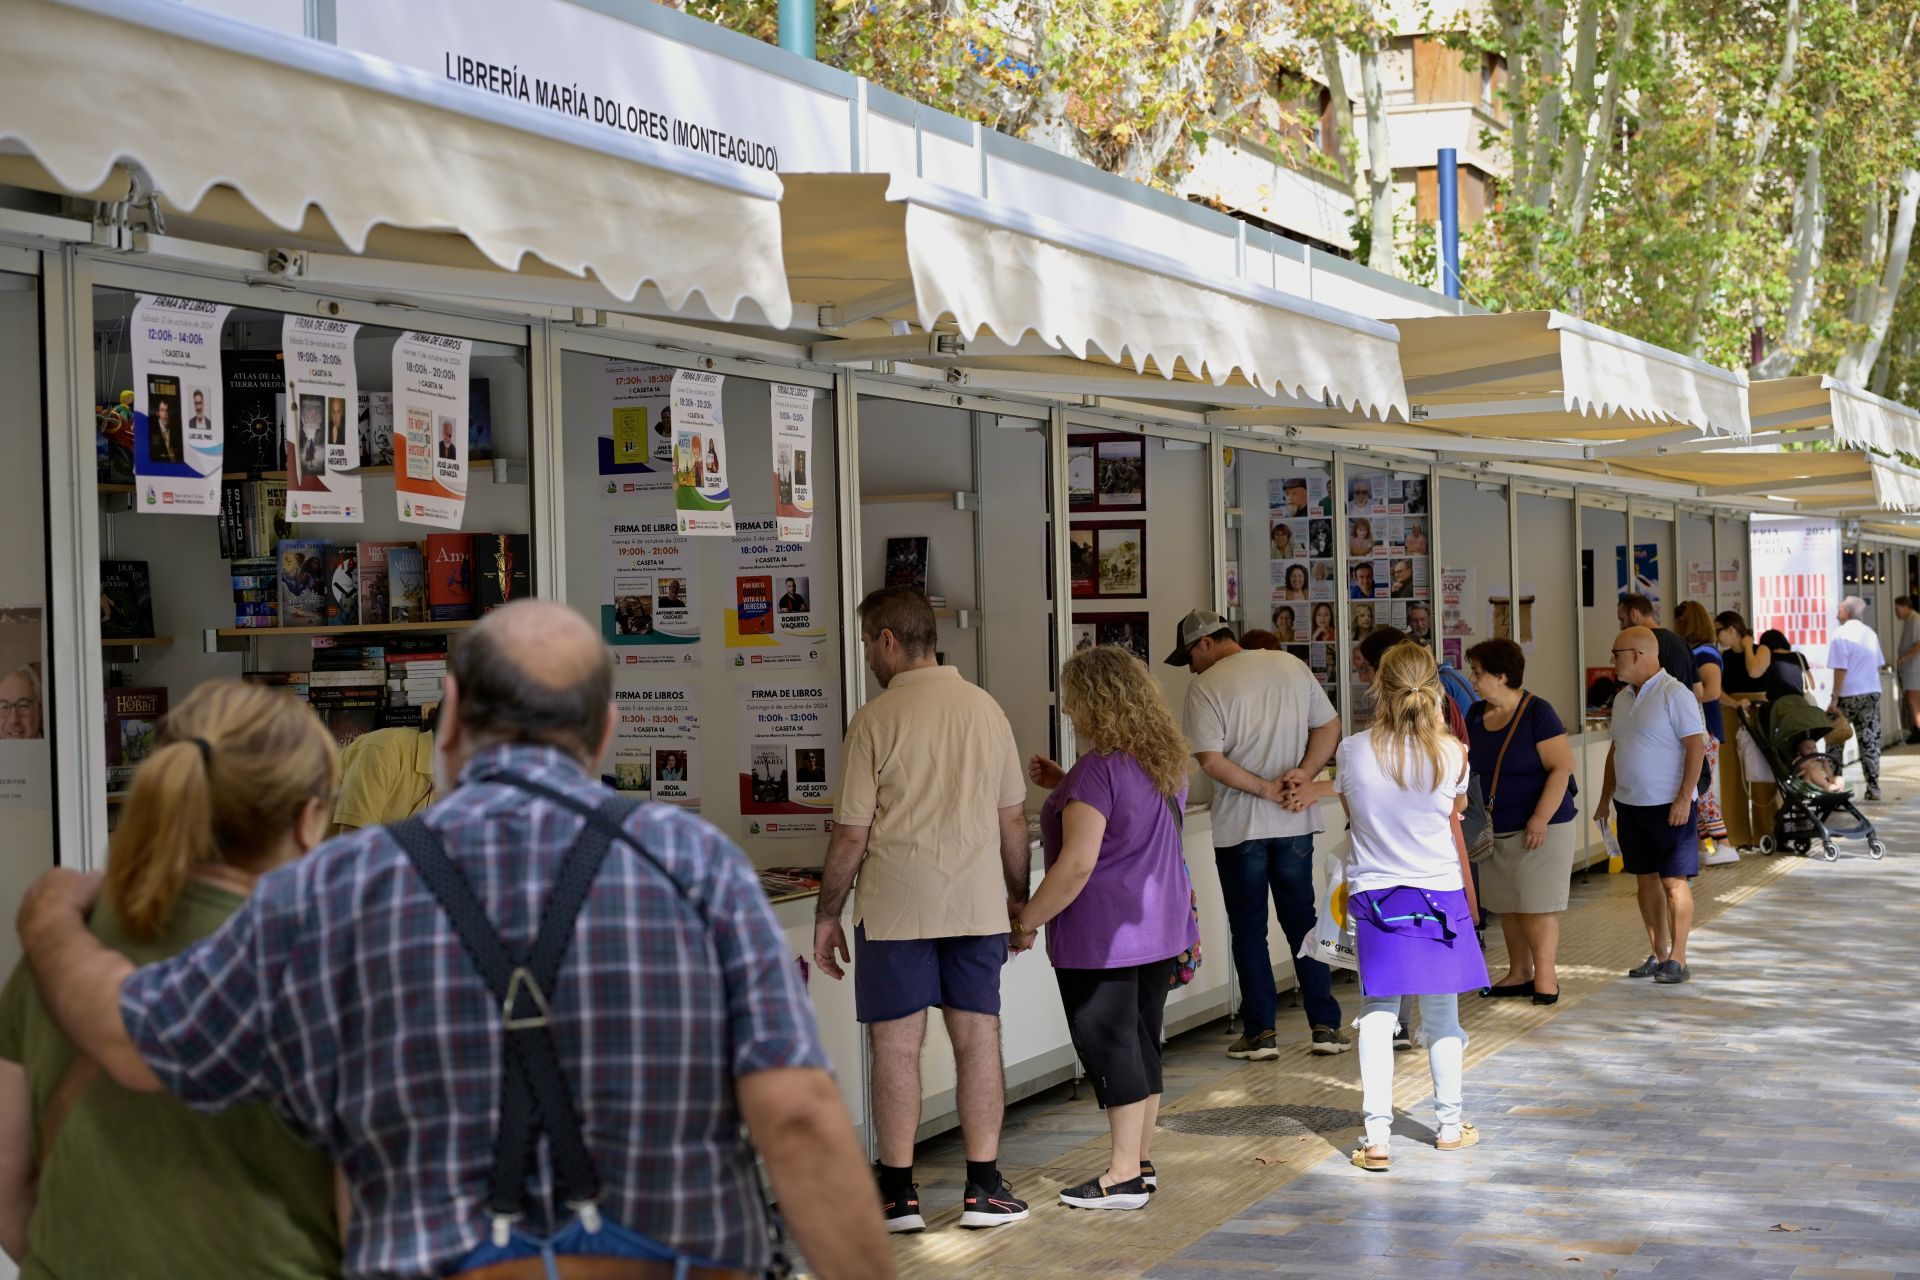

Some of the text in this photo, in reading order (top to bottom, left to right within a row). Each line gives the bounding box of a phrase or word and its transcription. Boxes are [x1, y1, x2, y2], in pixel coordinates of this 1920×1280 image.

[446, 52, 779, 173] LIBRERÍA MARÍA DOLORES (MONTEAGUDO)
[152, 296, 218, 314] FIRMA DE LIBROS
[294, 317, 348, 333] FIRMA DE LIBROS
[148, 328, 203, 345] 12:00h 14:00h
[410, 332, 463, 350] FIRMA DE LIBROS
[165, 349, 185, 359] CASETA
[297, 351, 343, 366] 19:00h 21:00h
[233, 372, 257, 380] ATLAS
[311, 369, 328, 377] CASETA
[406, 362, 456, 381] 18:00h 20:00h
[616, 373, 674, 385] 17:30h 18:30h
[701, 374, 717, 384] LIBROS
[421, 380, 438, 389] CASETA
[632, 386, 654, 394] CASETA
[234, 488, 243, 540] SILO
[614, 523, 678, 533] FIRMA DE LIBRO
[735, 520, 774, 530] FIRMA DE
[618, 545, 679, 556] 19:00h 21:00h
[741, 543, 803, 554] 18:00h 21:00h
[743, 602, 767, 610] DERECHA
[615, 691, 684, 700] FIRMA DE LIBROS
[751, 688, 823, 698] FIRMA DE LIBROS
[116, 696, 158, 713] HOBBIT
[621, 714, 679, 723] 11:30h 13:30h
[758, 712, 818, 722] 11:00h 13:00h
[753, 758, 785, 766] MATARTE
[795, 783, 810, 791] JOSÉ
